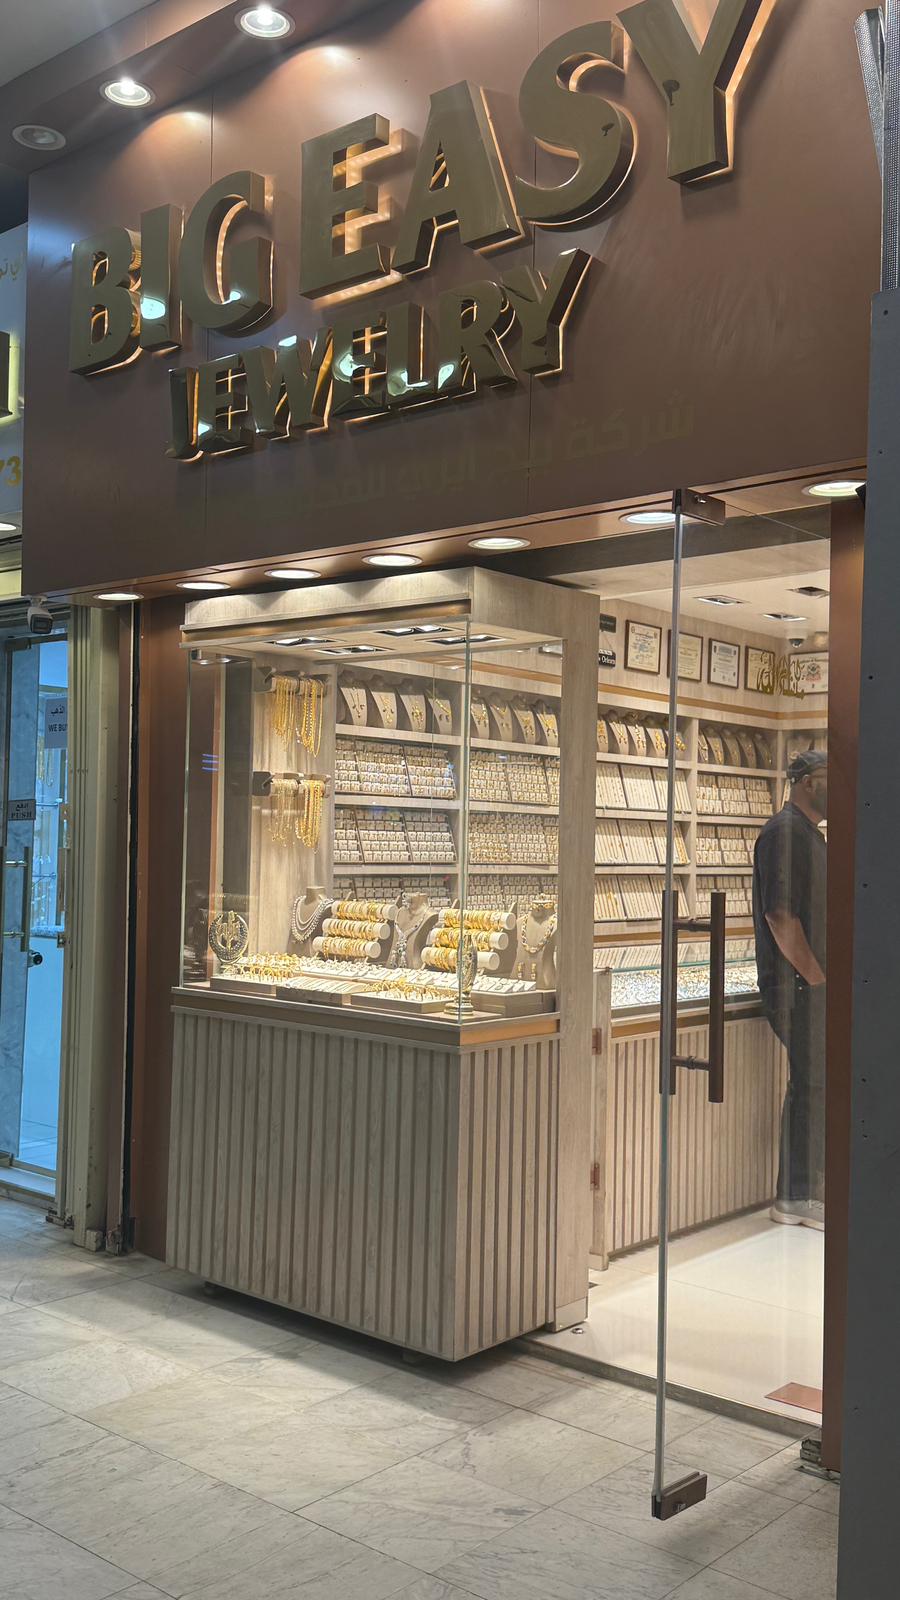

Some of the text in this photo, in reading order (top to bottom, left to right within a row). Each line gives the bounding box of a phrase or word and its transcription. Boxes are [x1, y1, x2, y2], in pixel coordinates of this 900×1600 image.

[70, 0, 768, 376] BIG EASY
[166, 248, 592, 461] JEWELRY
[563, 388, 696, 462] شركة
[48, 723, 58, 732] WE
[11, 811, 32, 819] PUSH
